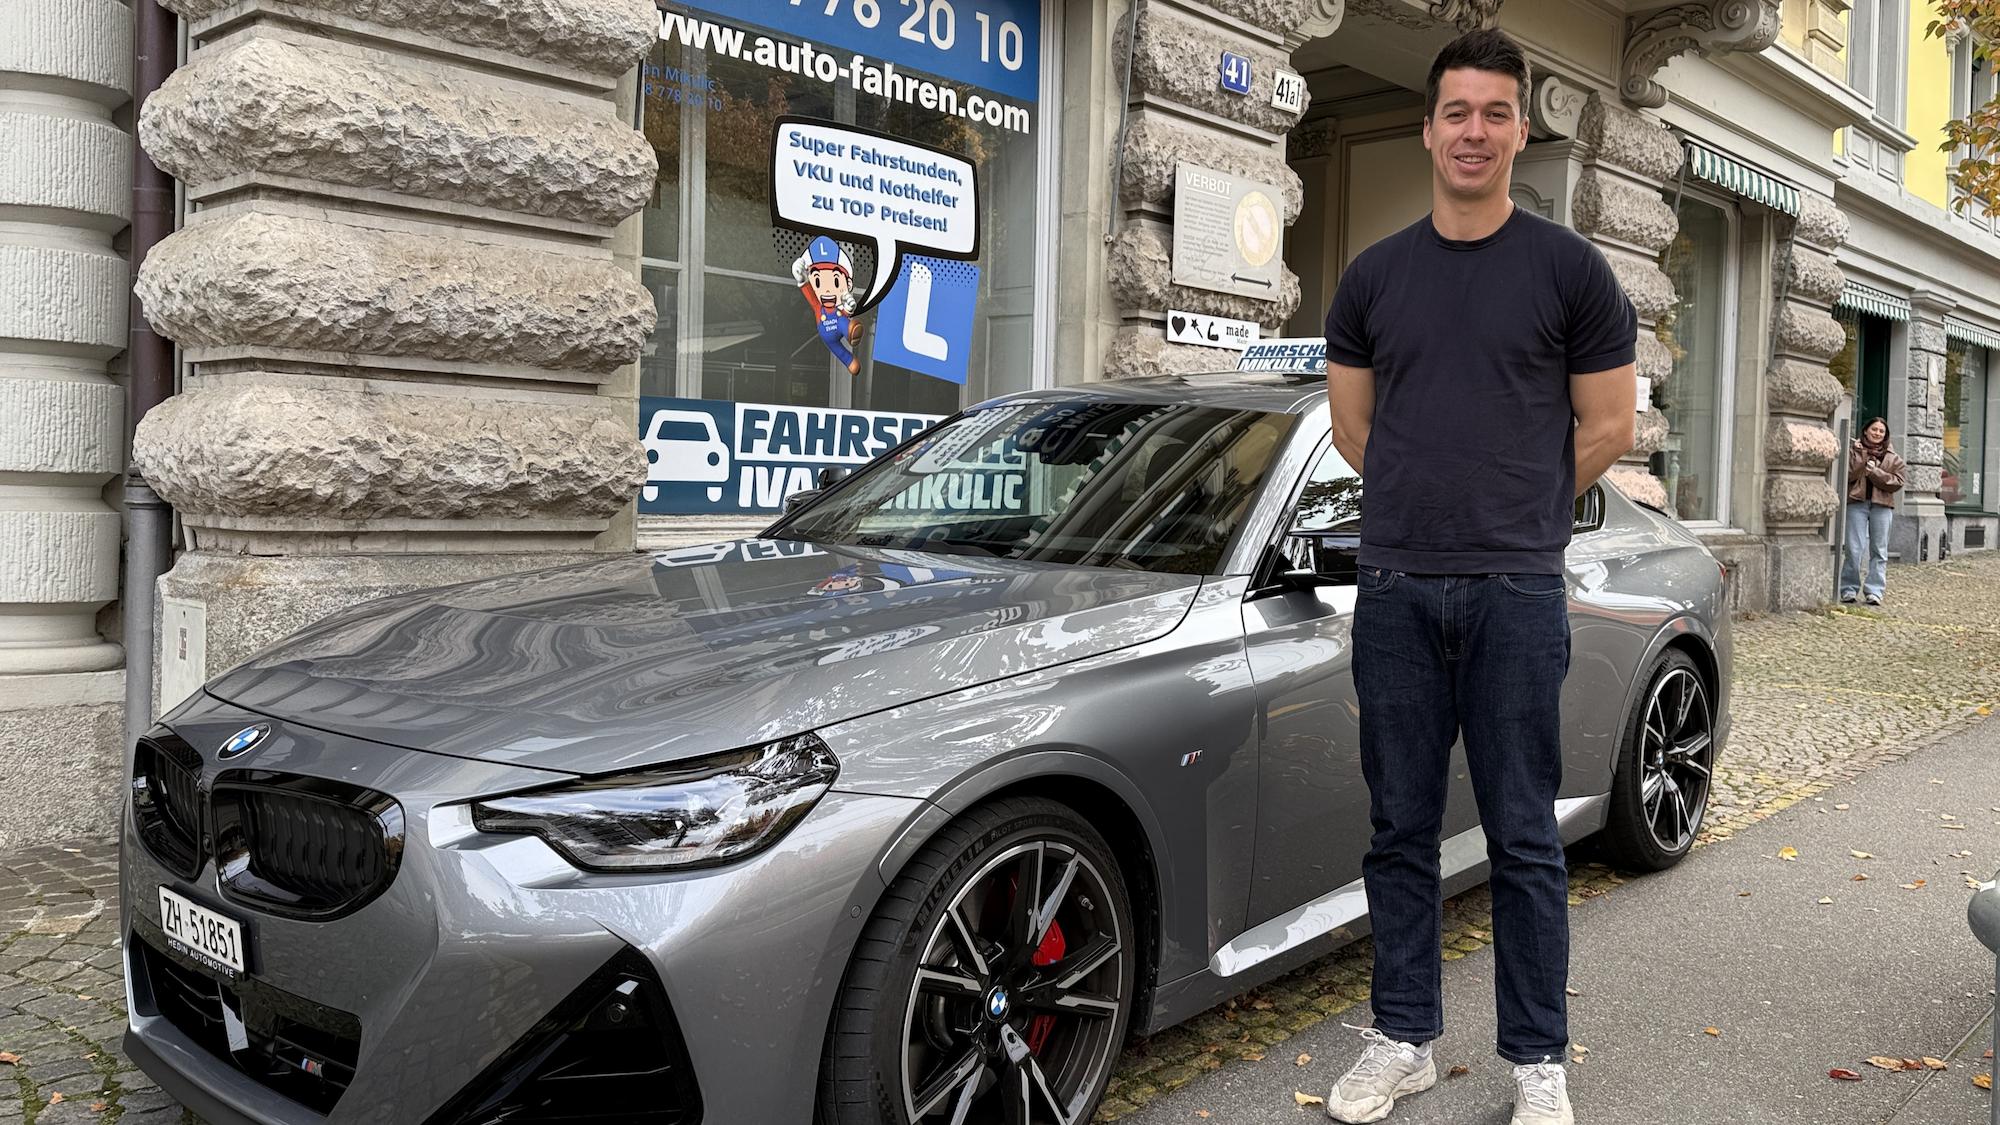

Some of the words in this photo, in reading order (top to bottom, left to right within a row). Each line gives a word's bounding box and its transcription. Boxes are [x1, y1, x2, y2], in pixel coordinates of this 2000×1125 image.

[900, 0, 955, 50] 20
[976, 11, 1023, 71] 10
[1225, 57, 1248, 88] 41
[657, 85, 682, 104] 778
[789, 131, 846, 157] Super
[851, 145, 963, 186] Fahrstunden,
[793, 160, 833, 183] VKU
[839, 171, 874, 192] und
[880, 178, 959, 208] Nothelfer
[1184, 171, 1232, 196] VERBOT
[812, 194, 834, 212] zu
[840, 197, 875, 218] TOP
[881, 206, 948, 233] Preisen!
[820, 242, 828, 256] L
[902, 262, 949, 362] L
[1226, 324, 1249, 338] made
[1239, 358, 1310, 371] MIKULIC
[738, 466, 852, 508] IVA
[189, 908, 239, 965] 51851
[167, 937, 188, 955] HEDIN
[190, 949, 234, 979] AUTOMOTIVE
